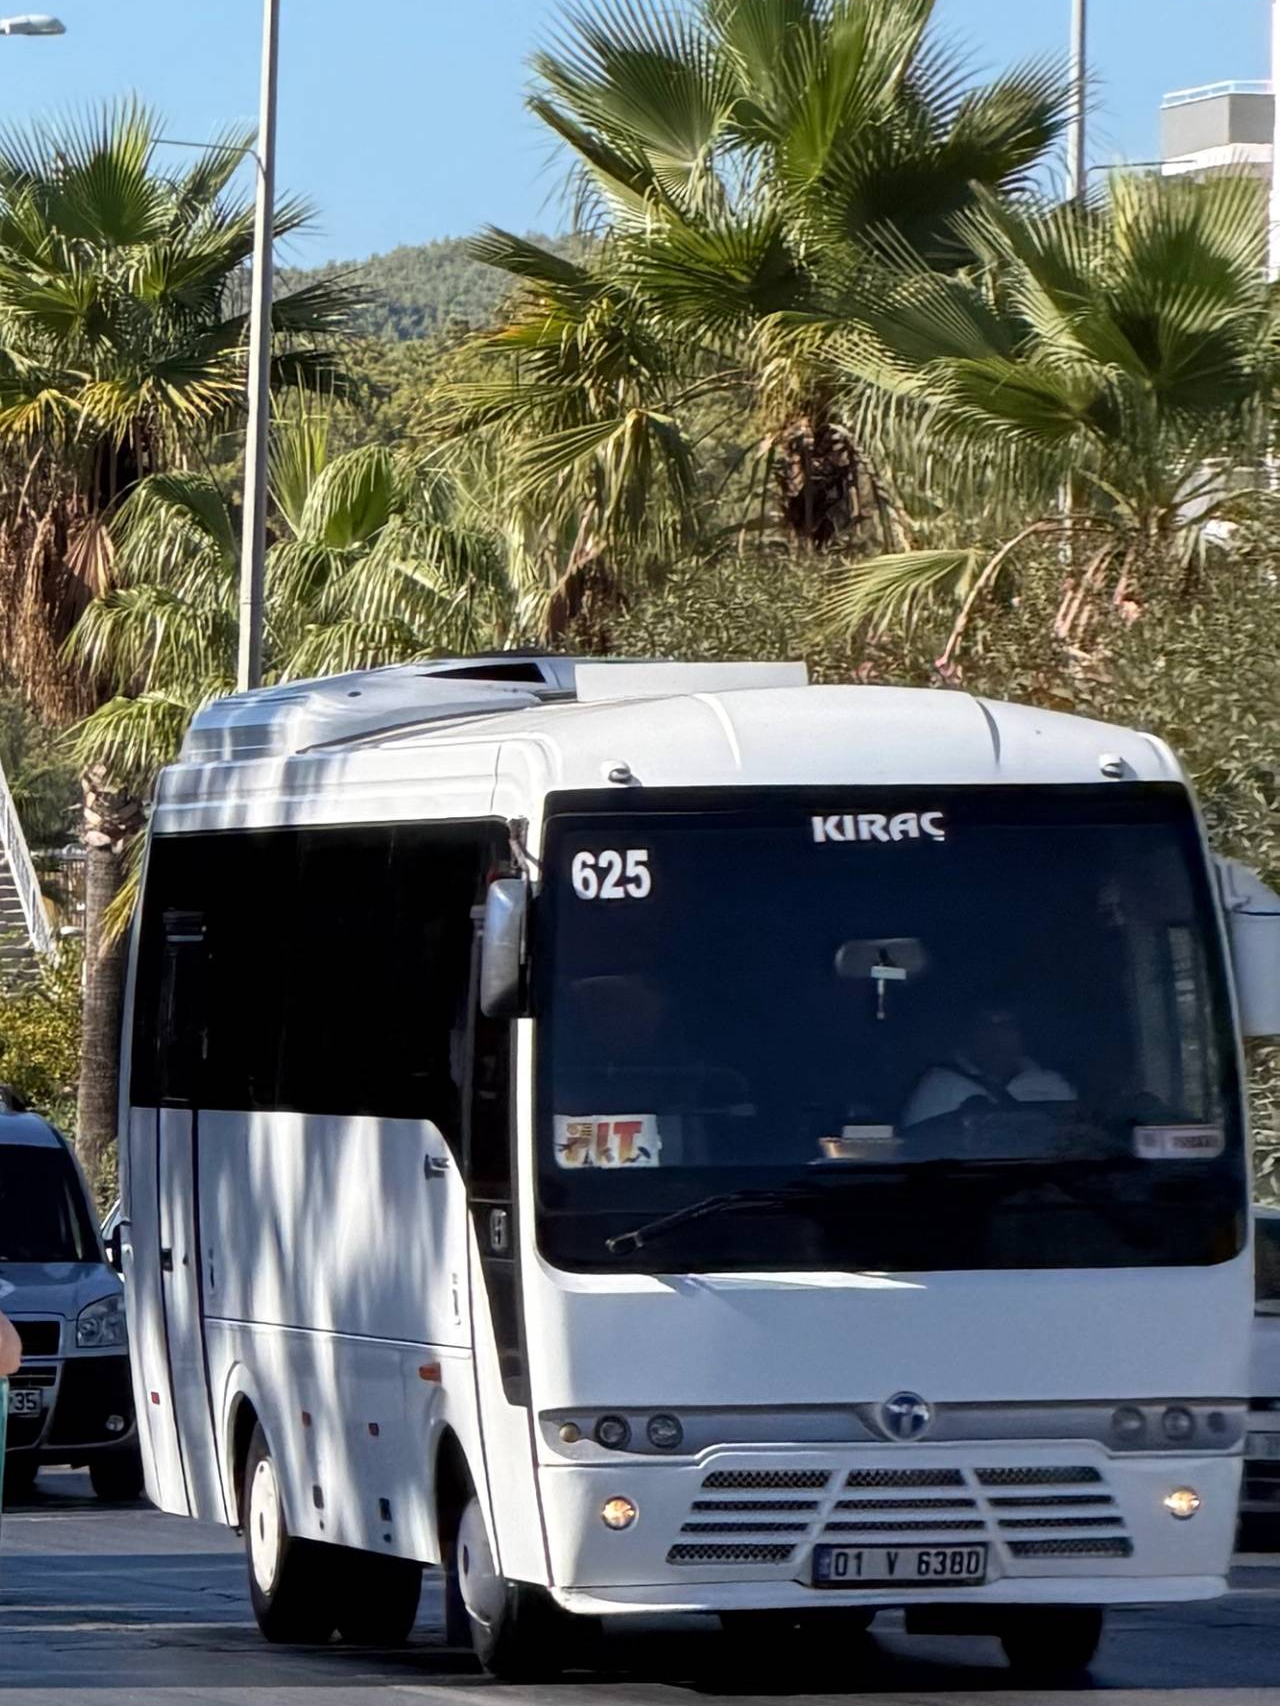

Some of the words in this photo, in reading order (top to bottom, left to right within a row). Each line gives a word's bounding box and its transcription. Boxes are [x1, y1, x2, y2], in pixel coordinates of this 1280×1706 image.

[812, 812, 945, 842] KIRAÇ
[572, 849, 651, 900] 625
[835, 1551, 863, 1576] 01
[887, 1551, 898, 1575] V
[917, 1550, 980, 1576] 6380
